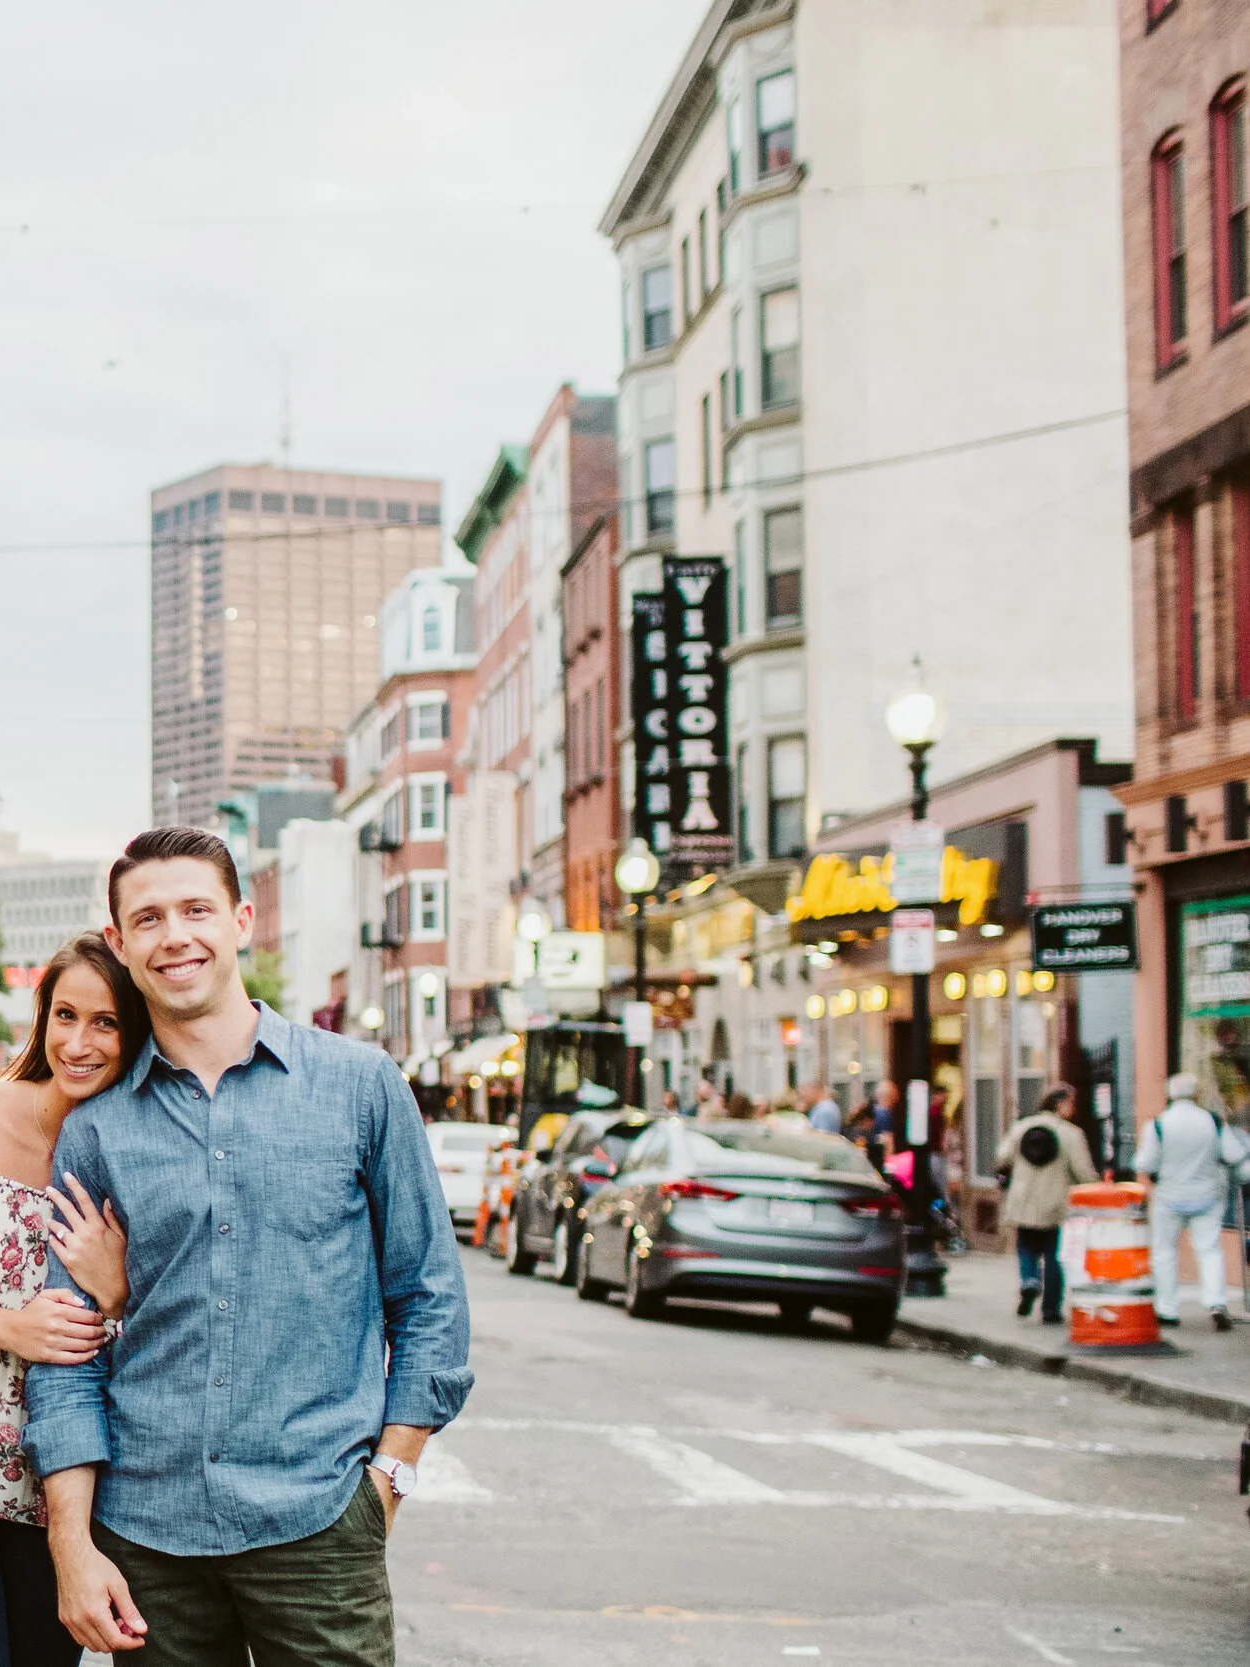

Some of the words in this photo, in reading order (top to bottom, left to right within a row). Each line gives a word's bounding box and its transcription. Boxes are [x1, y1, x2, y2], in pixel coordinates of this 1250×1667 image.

[676, 576, 719, 831] VITTORIA
[1041, 908, 1123, 928] HANOVER
[1065, 928, 1101, 946] DRY
[1040, 945, 1130, 966] CLEANERS
